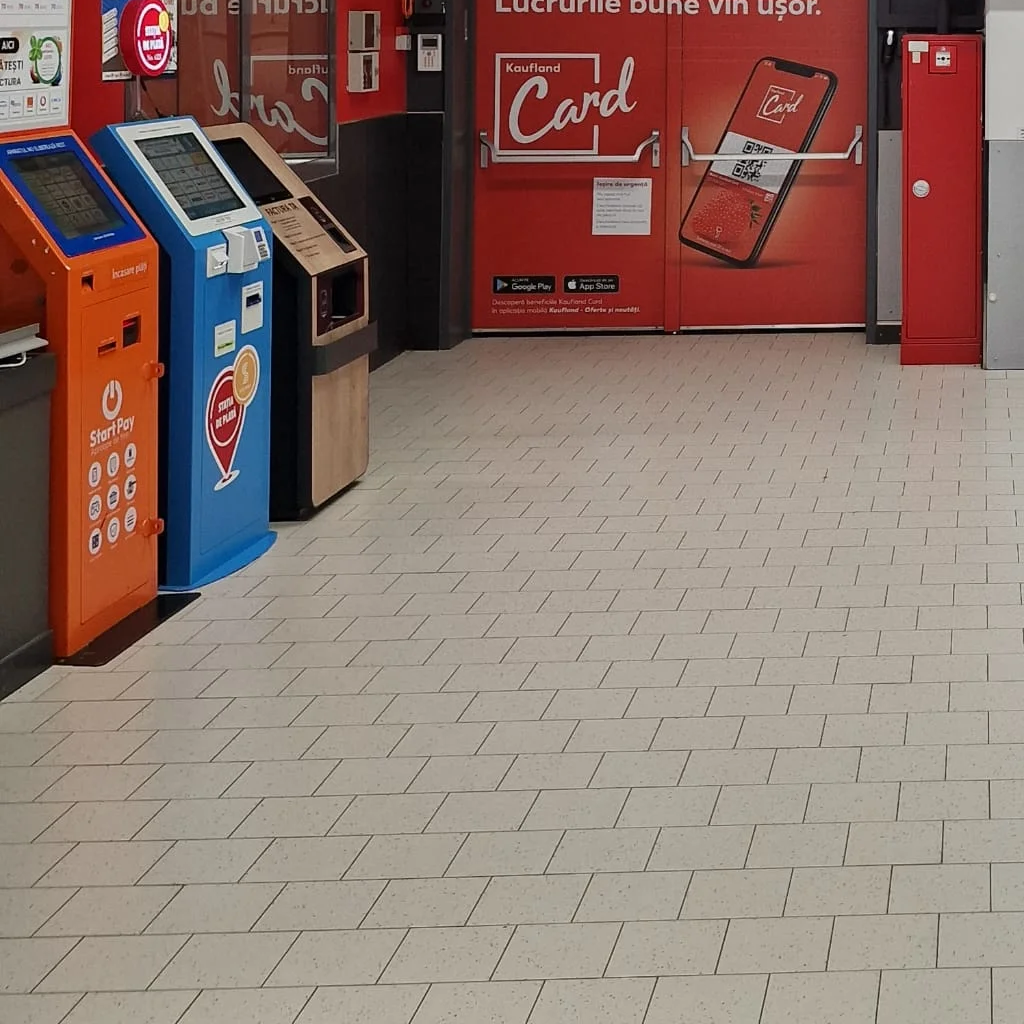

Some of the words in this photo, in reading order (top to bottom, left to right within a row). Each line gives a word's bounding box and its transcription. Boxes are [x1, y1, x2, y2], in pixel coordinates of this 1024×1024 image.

[505, 62, 561, 74] Kaufland
[508, 56, 637, 144] Card
[762, 93, 804, 116] Card
[512, 282, 537, 292] Google
[537, 282, 552, 292] Play
[579, 283, 595, 291] App
[595, 282, 616, 290] Store
